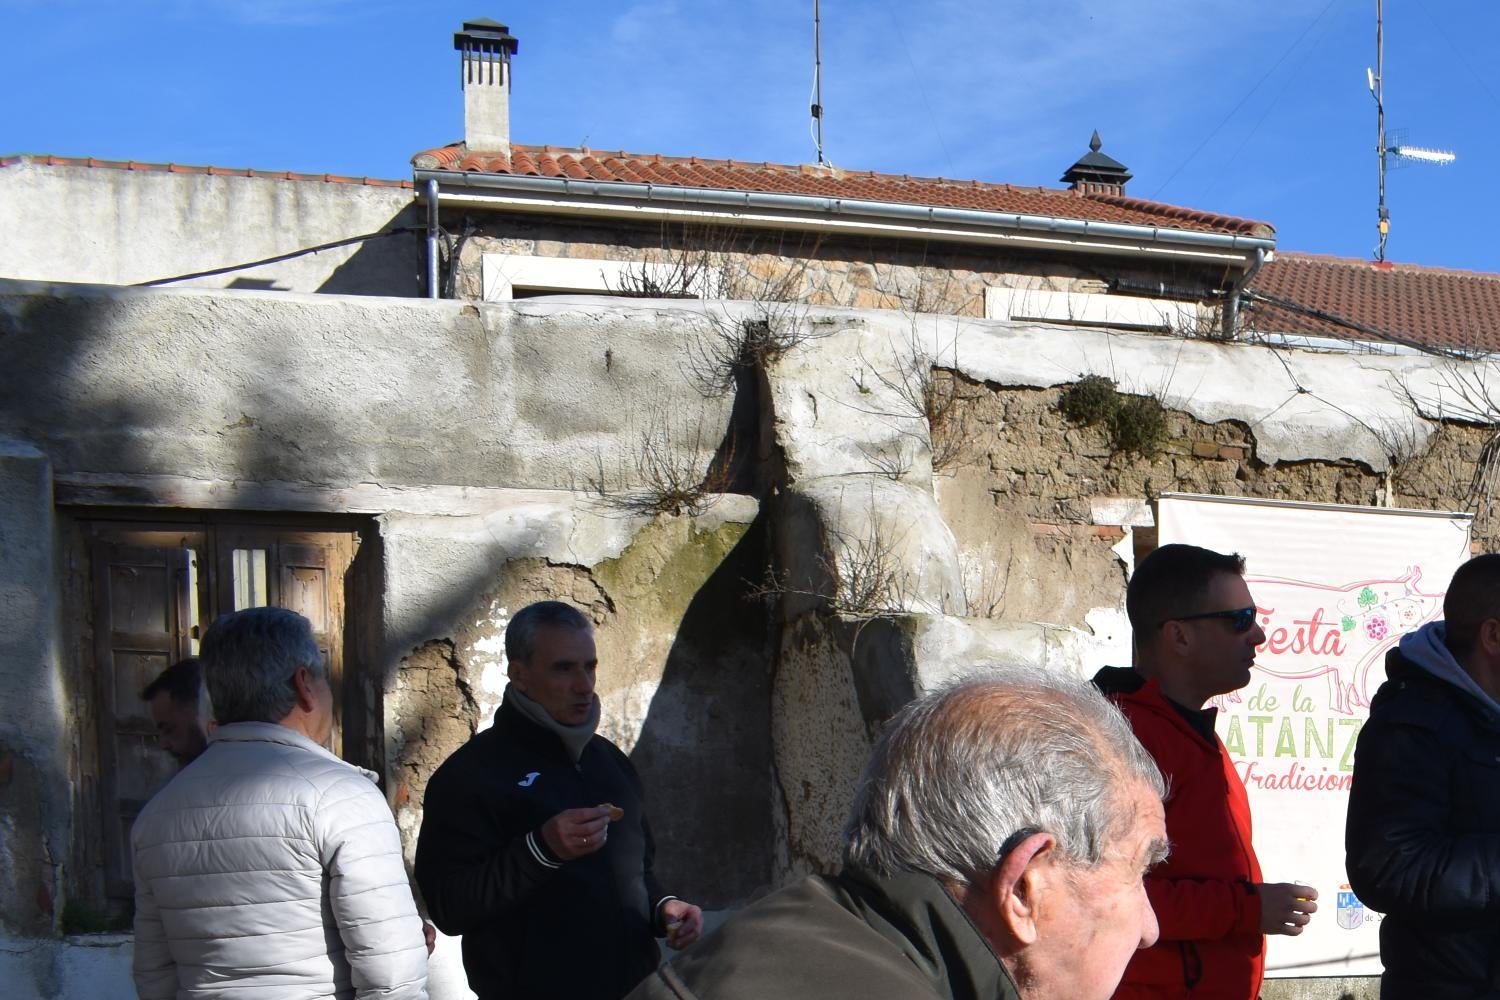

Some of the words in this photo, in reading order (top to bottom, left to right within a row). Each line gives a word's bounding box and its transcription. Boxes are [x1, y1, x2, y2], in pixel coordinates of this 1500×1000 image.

[1248, 682, 1281, 713] de
[1292, 683, 1316, 713] la
[1225, 714, 1363, 772] ATANZ
[1234, 761, 1353, 791] Tradicion
